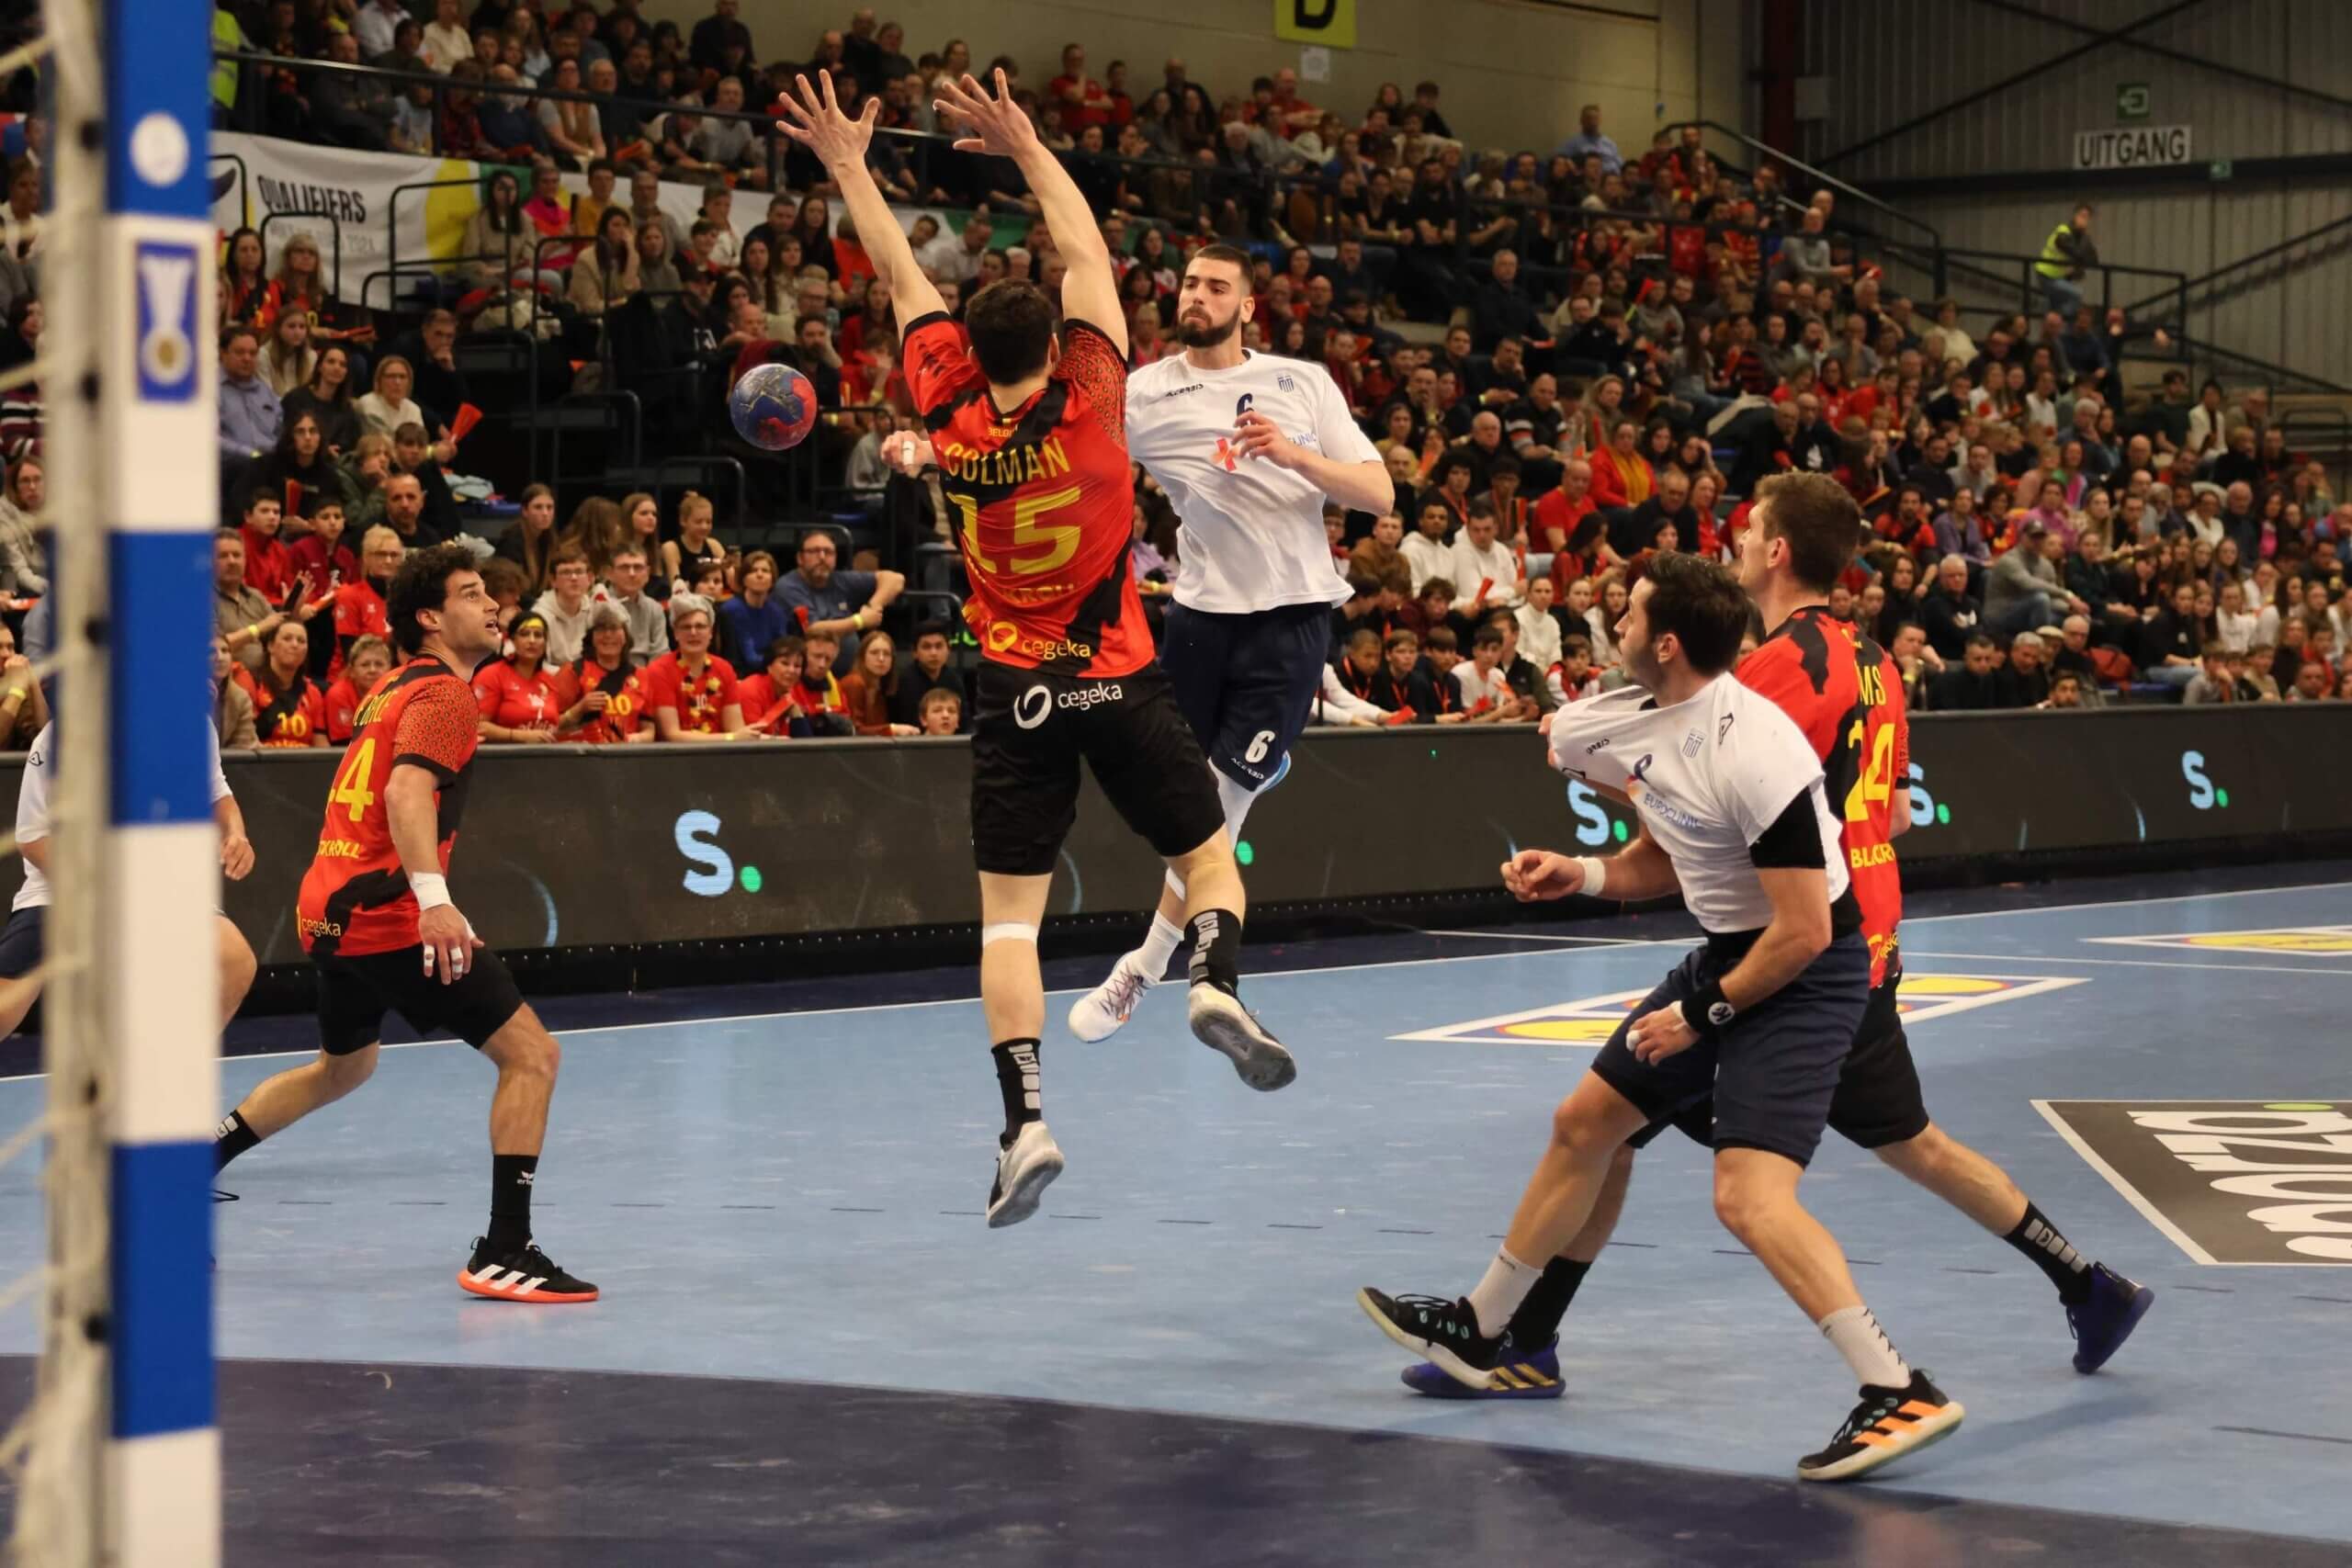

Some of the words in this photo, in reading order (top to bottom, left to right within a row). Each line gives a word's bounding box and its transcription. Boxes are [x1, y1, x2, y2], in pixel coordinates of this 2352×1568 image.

[2079, 129, 2186, 166] UITGANG
[944, 436, 1071, 485] COLMAN
[946, 486, 1081, 574] 15
[1022, 638, 1091, 660] cegeka
[1057, 682, 1123, 711] cegeka
[1245, 729, 1276, 763] 6
[1848, 720, 1895, 822] 24
[300, 917, 341, 937] cegeka
